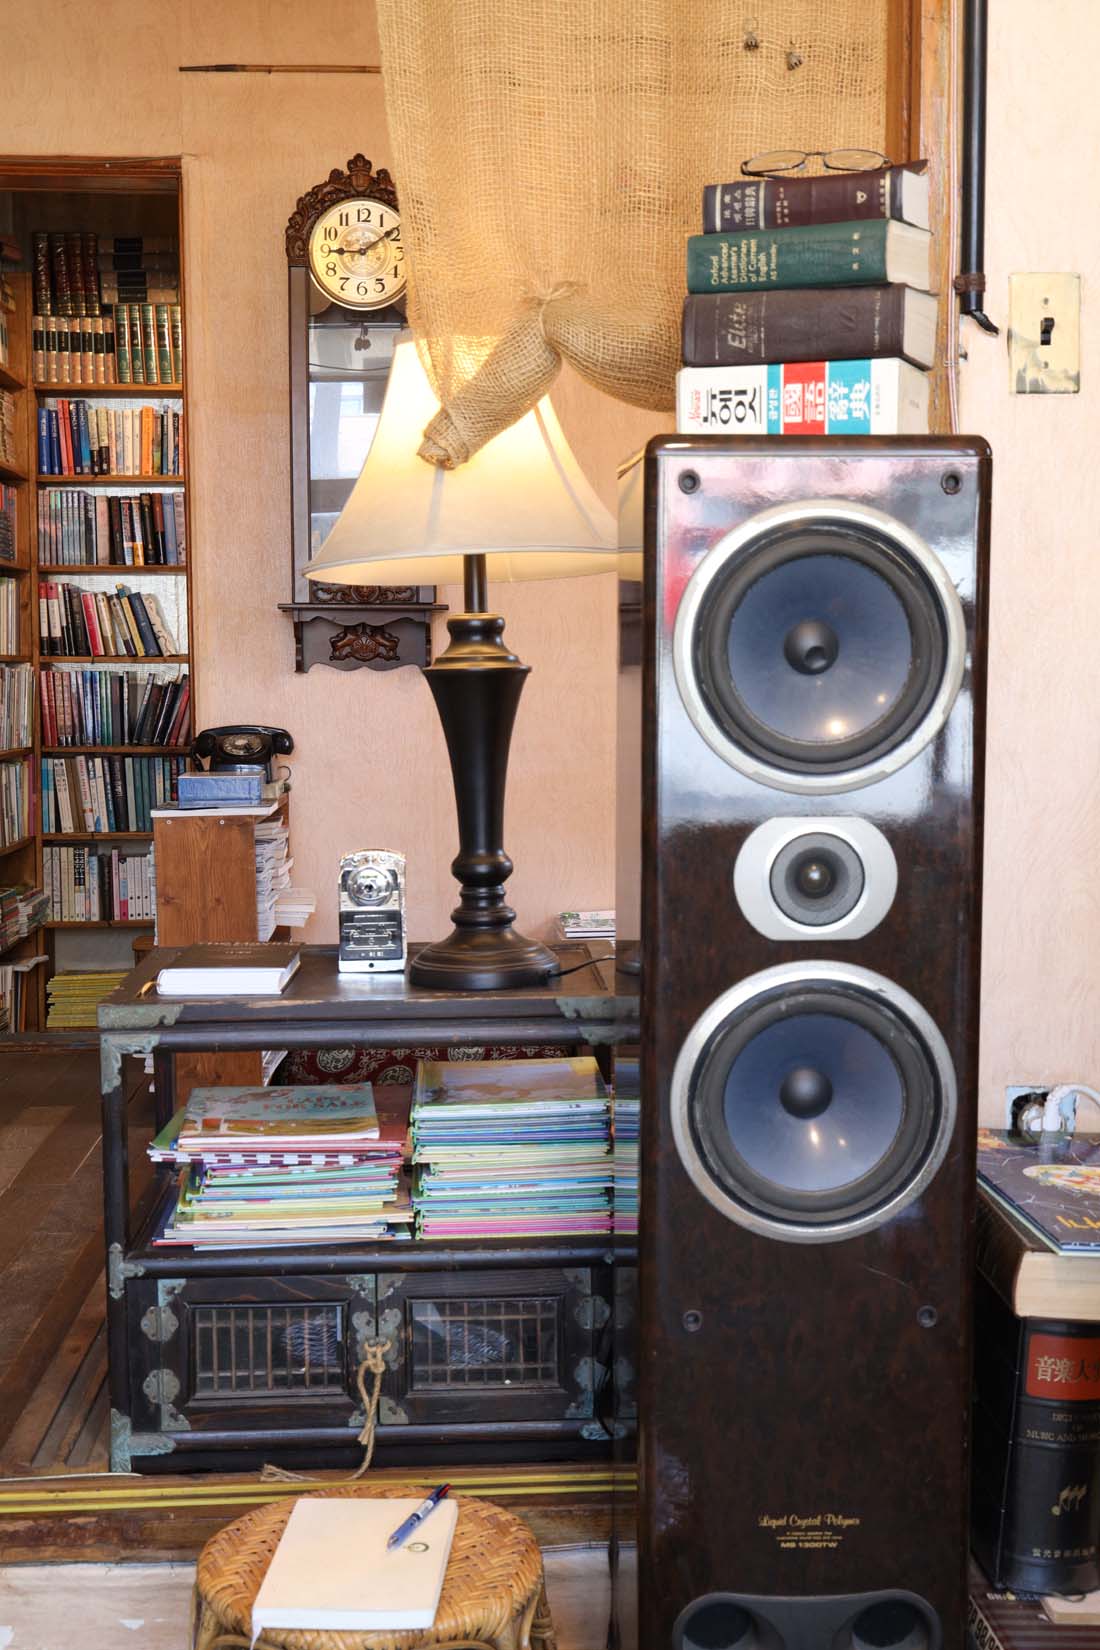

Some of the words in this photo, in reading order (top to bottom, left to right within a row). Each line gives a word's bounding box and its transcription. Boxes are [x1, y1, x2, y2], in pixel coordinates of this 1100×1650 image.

[339, 212, 349, 226] 11
[357, 208, 371, 222] 12
[379, 213, 384, 227] 1
[324, 227, 338, 241] 10
[390, 227, 401, 242] 2
[320, 244, 331, 258] 9
[395, 246, 405, 262] 3
[749, 239, 758, 271] Current
[719, 242, 729, 285] Advanced
[730, 246, 738, 284] Learner's
[739, 239, 749, 283] Dictionary
[758, 252, 768, 282] English
[325, 261, 336, 276] 8
[387, 264, 400, 278] 4
[710, 255, 719, 285] Oxford
[339, 277, 350, 291] 7
[375, 278, 385, 292] 5
[749, 274, 757, 283] of
[356, 281, 367, 295] 6
[727, 302, 747, 350] Elite
[788, 1514, 821, 1528] Crystal
